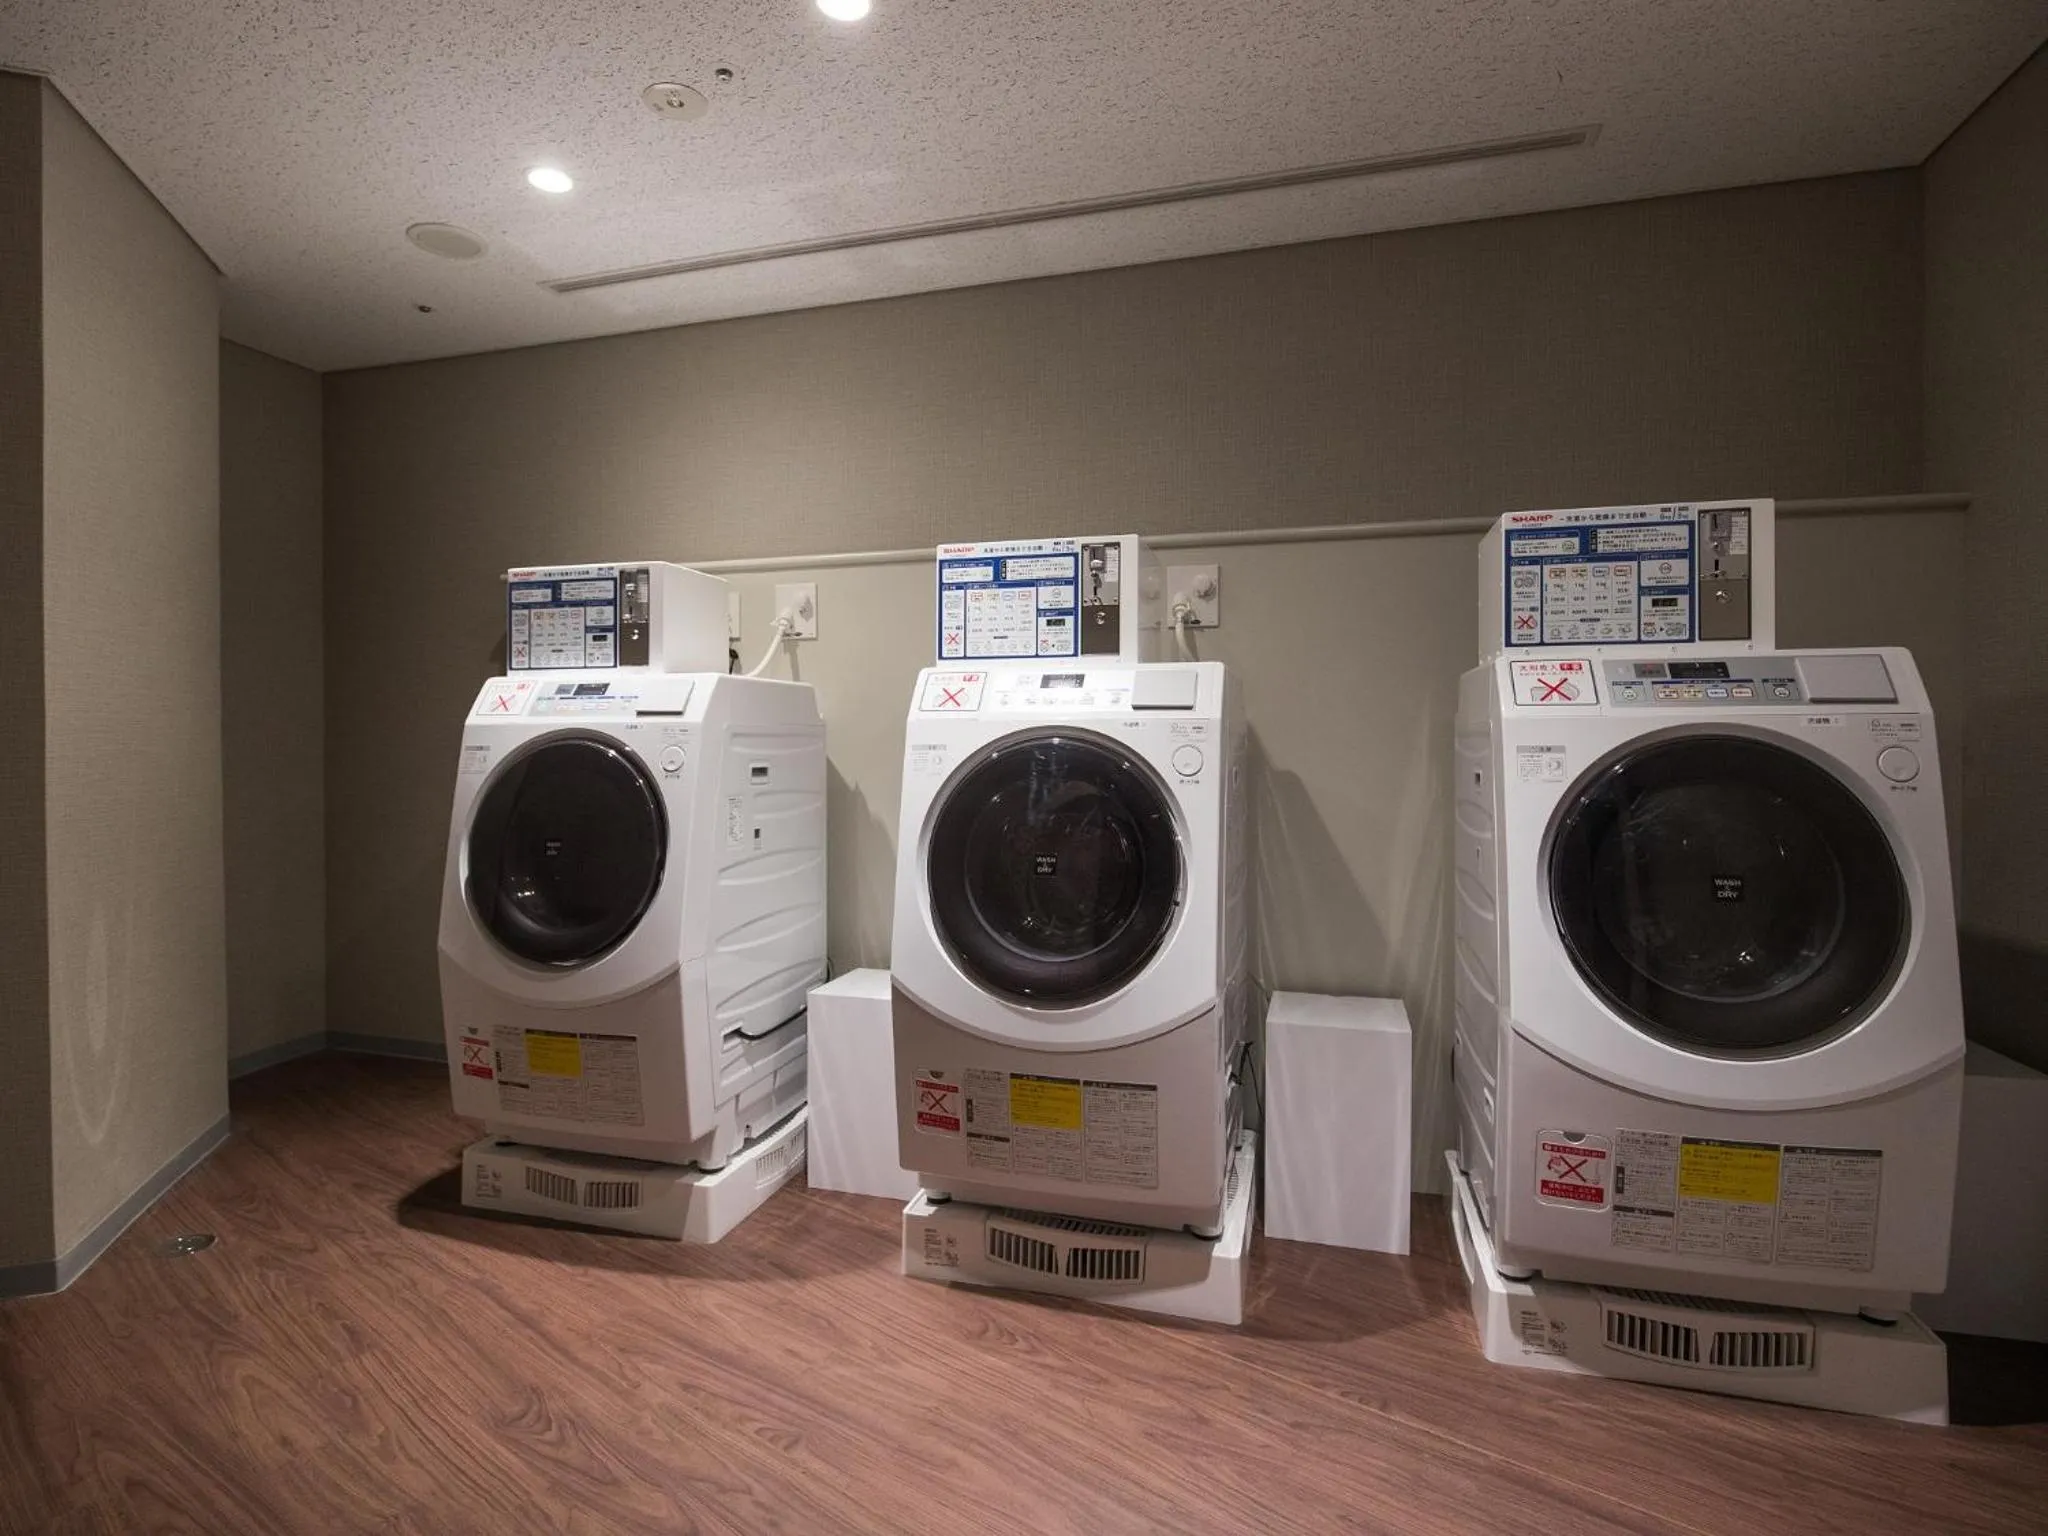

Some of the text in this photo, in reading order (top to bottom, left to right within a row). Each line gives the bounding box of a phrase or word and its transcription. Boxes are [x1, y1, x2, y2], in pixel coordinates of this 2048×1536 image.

[1512, 514, 1553, 523] SHARP
[1714, 878, 1741, 887] WASH
[1717, 891, 1739, 899] DRY
